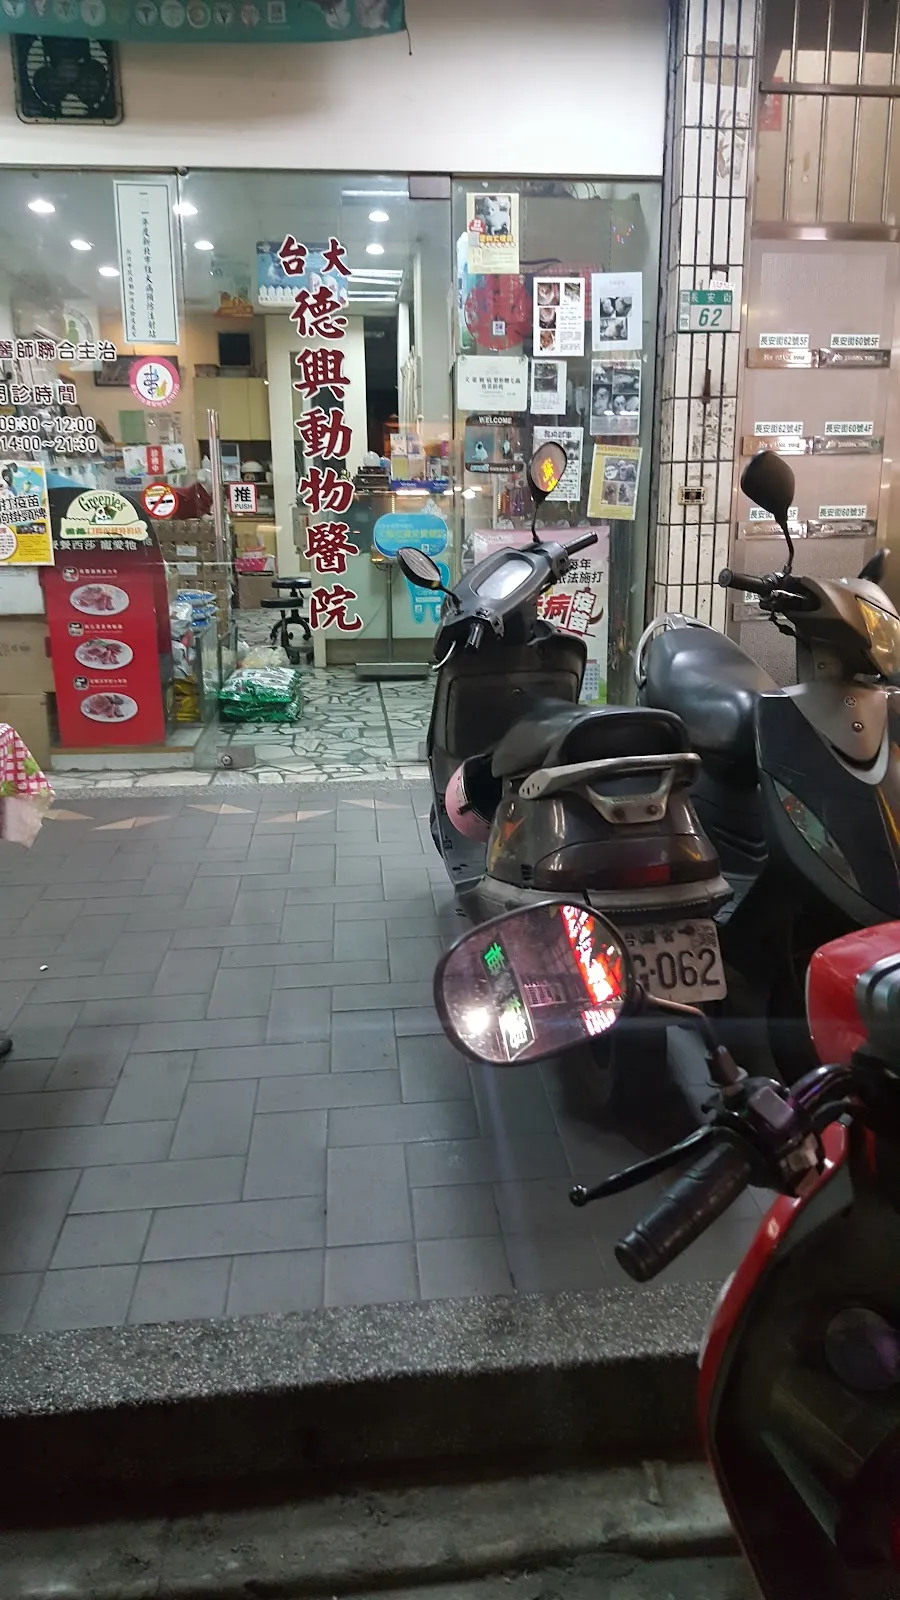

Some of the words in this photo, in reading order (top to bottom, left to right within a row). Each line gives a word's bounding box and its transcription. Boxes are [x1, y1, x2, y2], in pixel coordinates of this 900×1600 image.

[691, 292, 732, 303] 長安街
[698, 308, 722, 326] 62
[761, 336, 808, 346] 長安街62號5F
[832, 336, 879, 346] 長安街60號5F
[0, 340, 116, 359] 醫師聯合主治
[479, 416, 513, 424] WELCOME
[755, 424, 802, 433] 長安街62號4F
[826, 424, 872, 433] 長安街60號4F
[1, 437, 97, 451] 14:00~21:30
[291, 286, 362, 631] 德興動物醫院
[234, 486, 252, 502] 推
[78, 493, 127, 512] Greenies
[820, 508, 866, 517] 長安街60號3F
